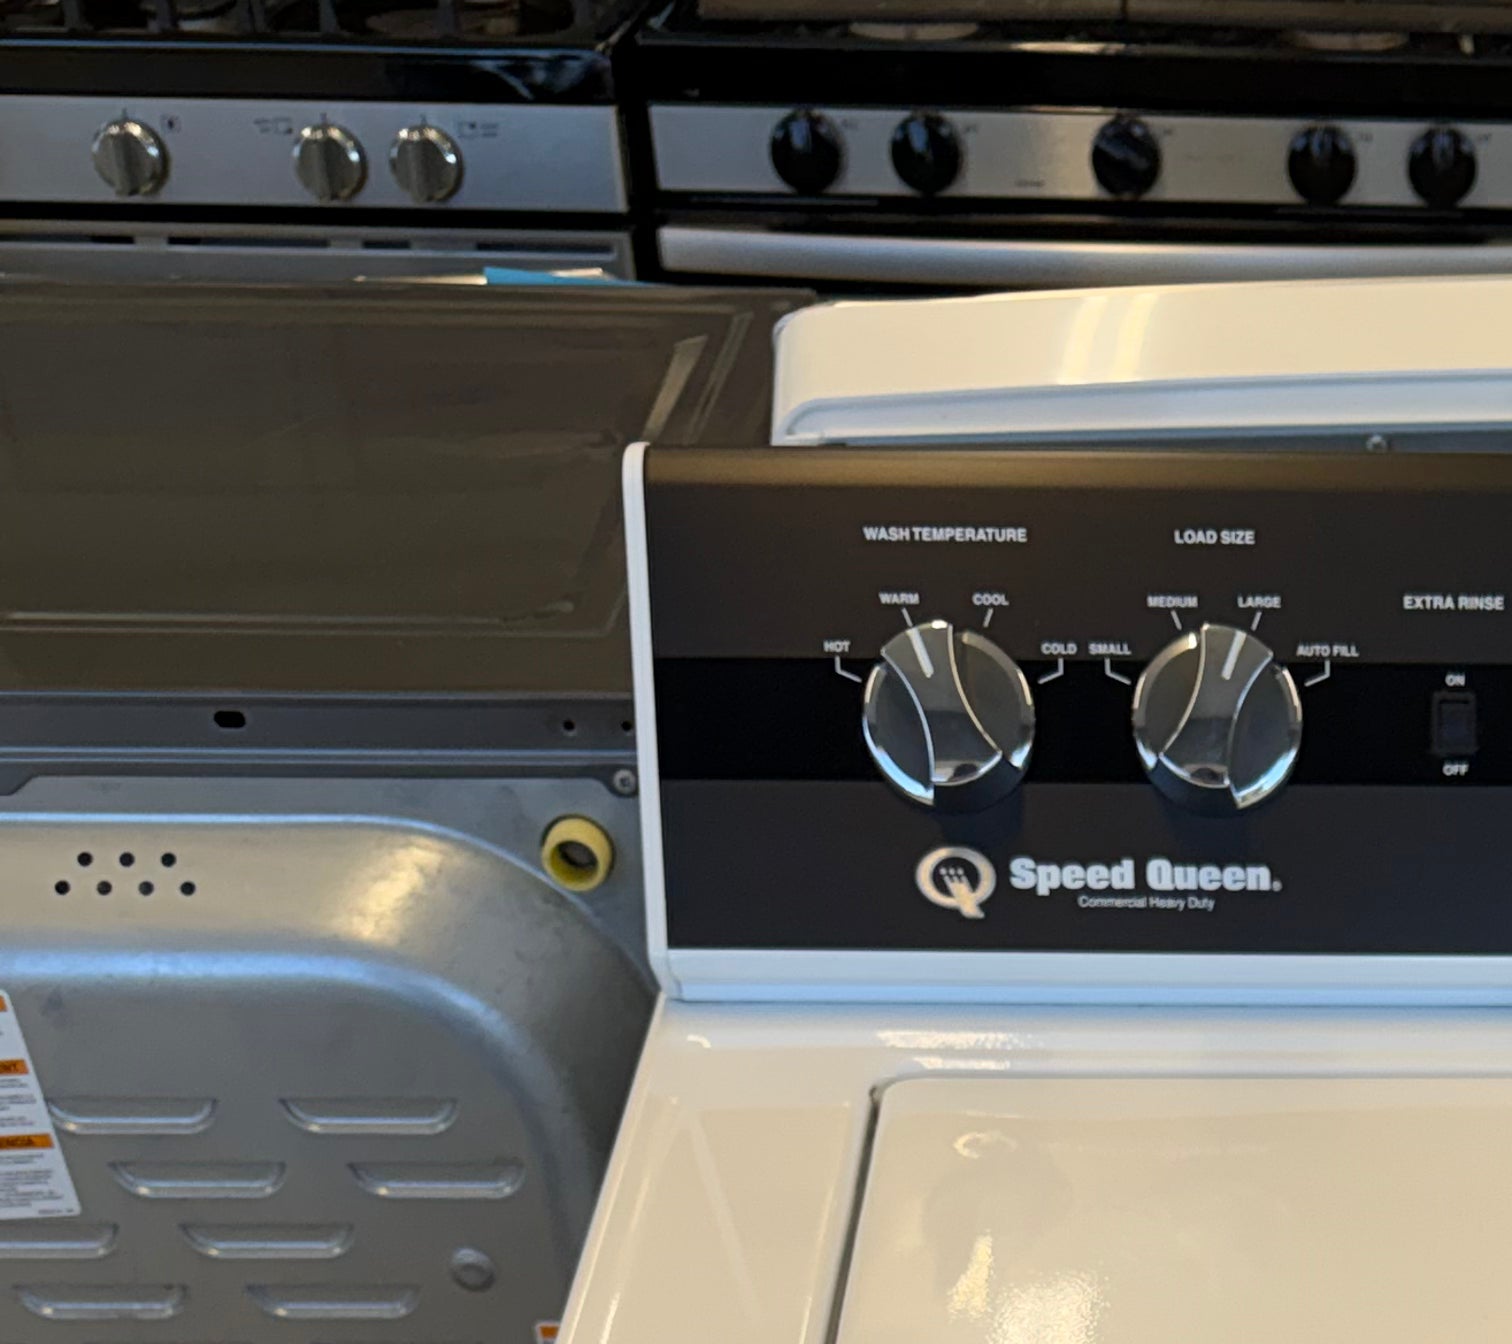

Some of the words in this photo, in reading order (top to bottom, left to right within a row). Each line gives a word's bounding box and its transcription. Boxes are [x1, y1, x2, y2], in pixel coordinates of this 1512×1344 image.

[863, 526, 910, 542] WASH
[912, 527, 1027, 543] TEMPERATURE
[1174, 529, 1217, 545] LOAD
[1220, 530, 1255, 545] SIZE
[879, 592, 919, 605] WARM
[972, 593, 1009, 606] COOL
[1147, 595, 1198, 608] MEDIUM
[1237, 595, 1281, 608] LARGE
[1403, 595, 1454, 610] EXTRA
[1458, 596, 1504, 610] RINSE
[824, 640, 850, 652] HOT
[1041, 642, 1077, 655] COLD
[1088, 642, 1131, 655] SMALL
[1297, 644, 1330, 657] AUTO
[1333, 645, 1359, 657] FILL
[1445, 673, 1465, 686] ON
[1443, 762, 1469, 776] OFF
[1010, 857, 1135, 896] Speed
[1078, 896, 1147, 909] Commercial
[1149, 897, 1185, 910] Heavy
[1188, 897, 1215, 911] Duty
